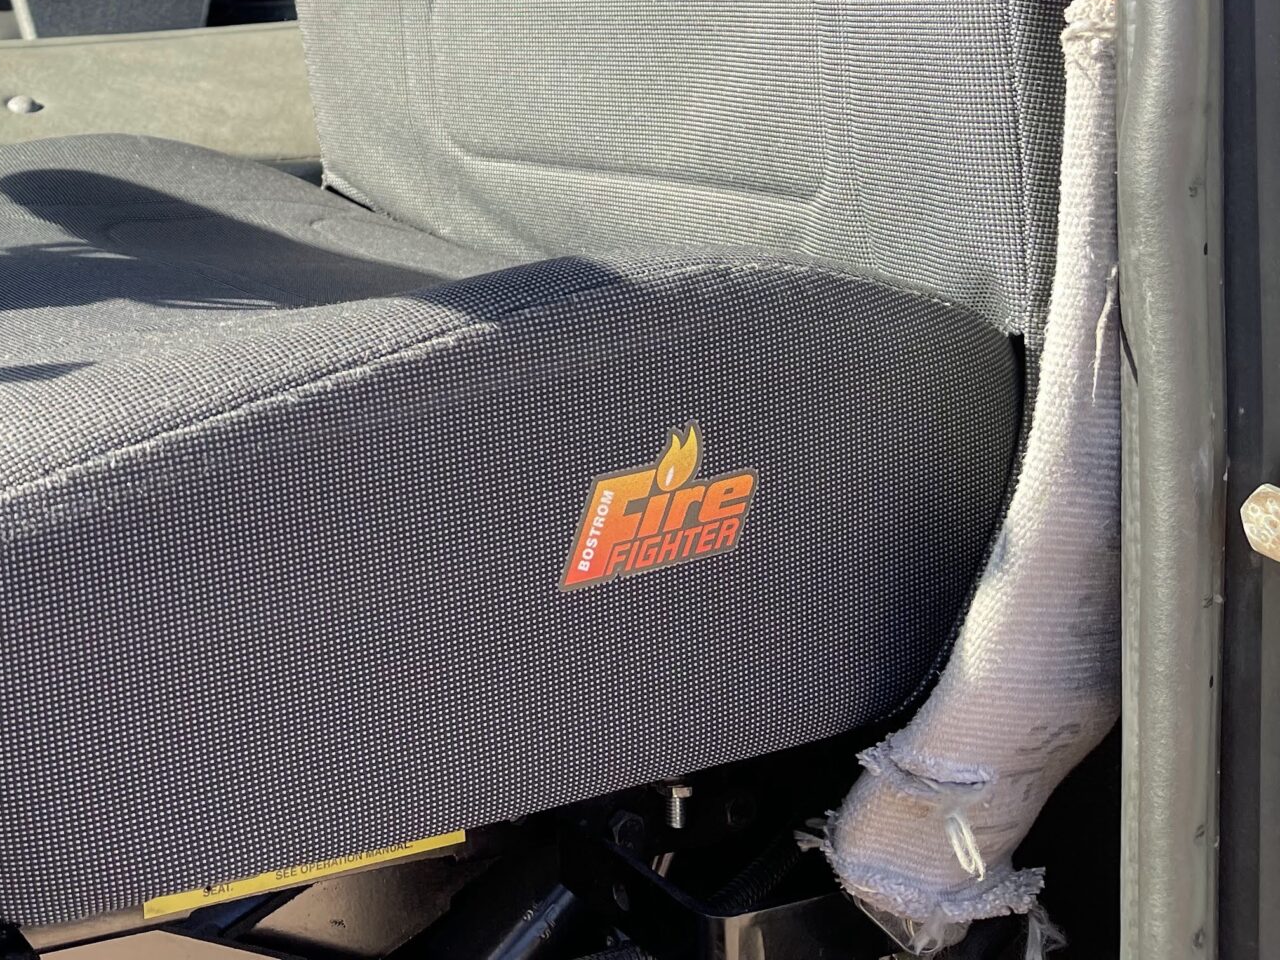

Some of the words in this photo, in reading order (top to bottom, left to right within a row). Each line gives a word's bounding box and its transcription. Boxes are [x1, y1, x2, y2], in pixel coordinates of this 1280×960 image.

[577, 490, 615, 572] BOSTROM
[606, 517, 740, 576] FIGHTER
[275, 865, 298, 880] SEE
[300, 850, 363, 874] OPERATION
[202, 882, 234, 897] SEAT.
